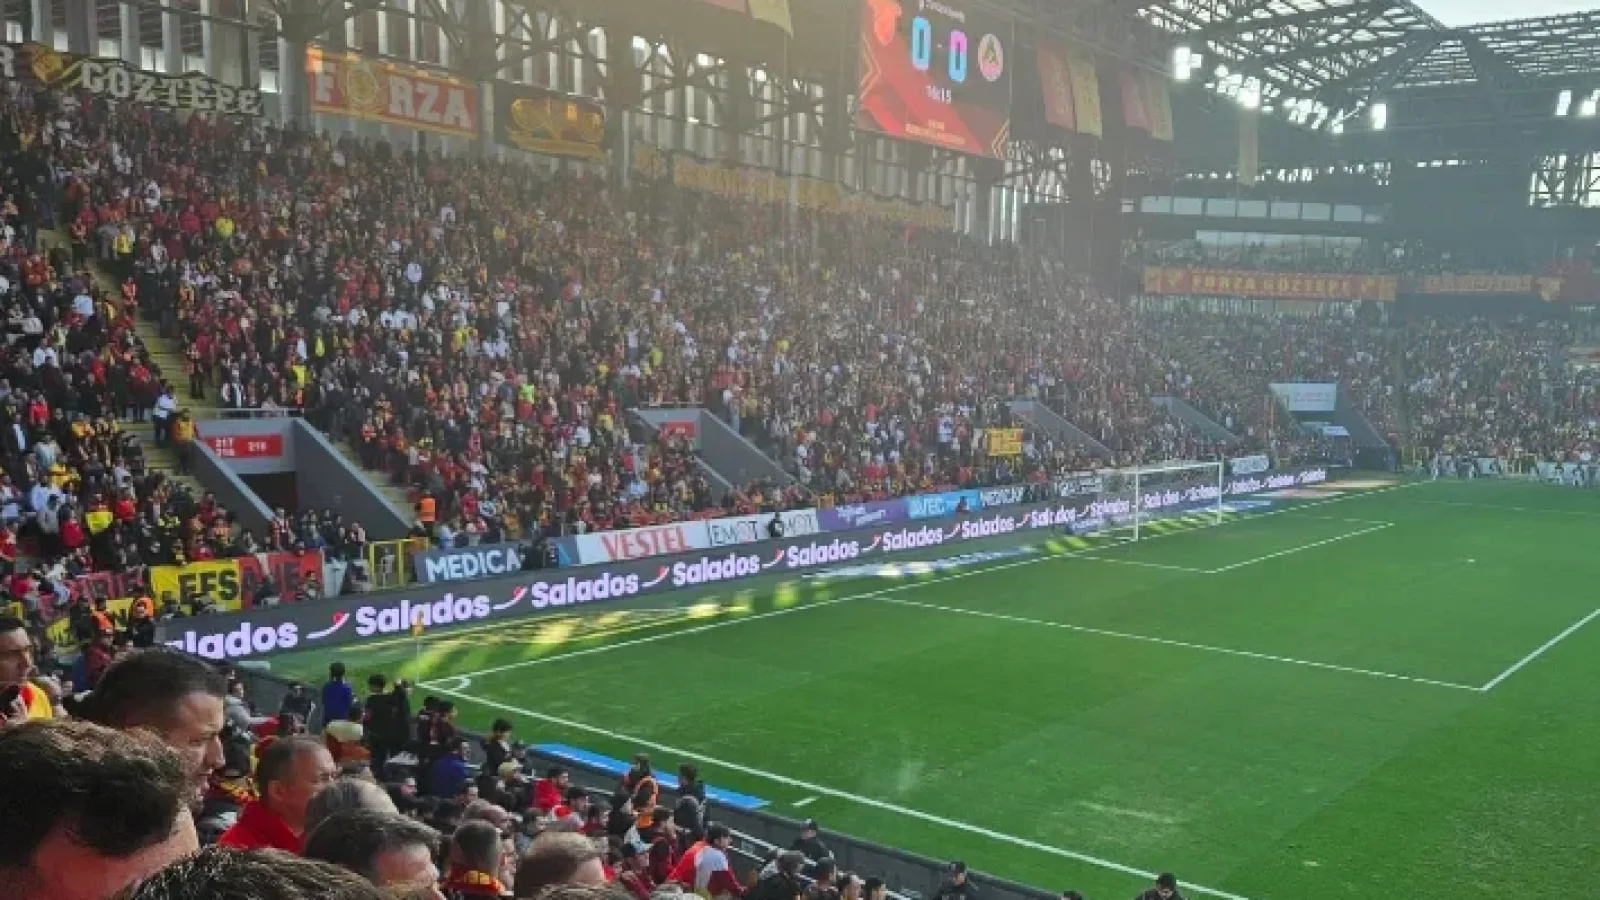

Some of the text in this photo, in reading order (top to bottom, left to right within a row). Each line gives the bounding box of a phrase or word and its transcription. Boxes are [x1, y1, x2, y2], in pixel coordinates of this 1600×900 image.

[912, 16, 931, 70] 0
[949, 29, 968, 84] 0
[355, 593, 491, 637] Salados
[531, 572, 639, 608] Salados
[672, 552, 760, 587] Salados
[787, 538, 859, 567] Salados
[882, 525, 943, 551] Salados
[961, 514, 1014, 539] Salados
[601, 526, 690, 561] VESTEL
